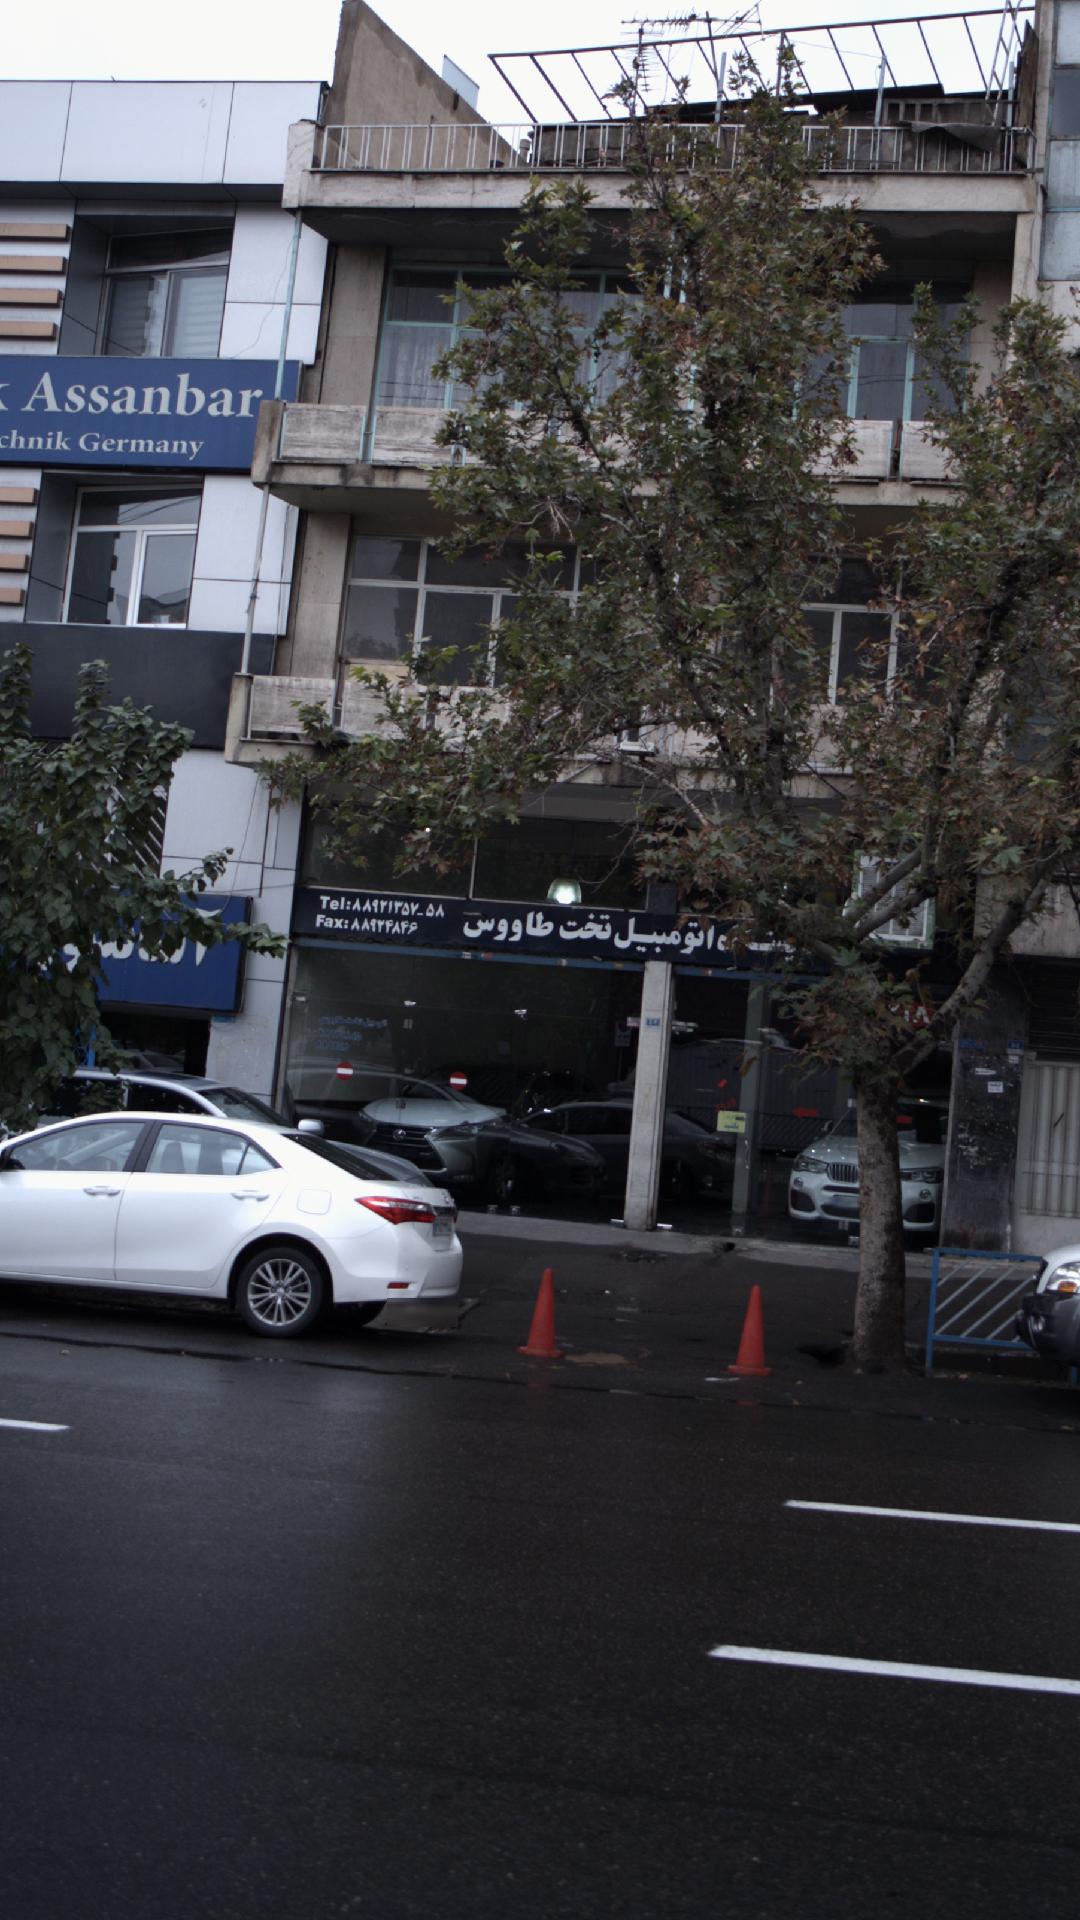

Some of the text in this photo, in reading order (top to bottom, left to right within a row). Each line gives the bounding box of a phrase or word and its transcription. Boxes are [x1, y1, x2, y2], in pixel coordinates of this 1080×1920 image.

[21, 373, 263, 418] Assanbar
[79, 432, 205, 461] Germany
[320, 895, 351, 911] Tel:
[315, 914, 349, 929] Fax:
[463, 911, 554, 942] طاووس
[559, 913, 612, 940] تخت
[613, 917, 715, 954] اتومبیل
